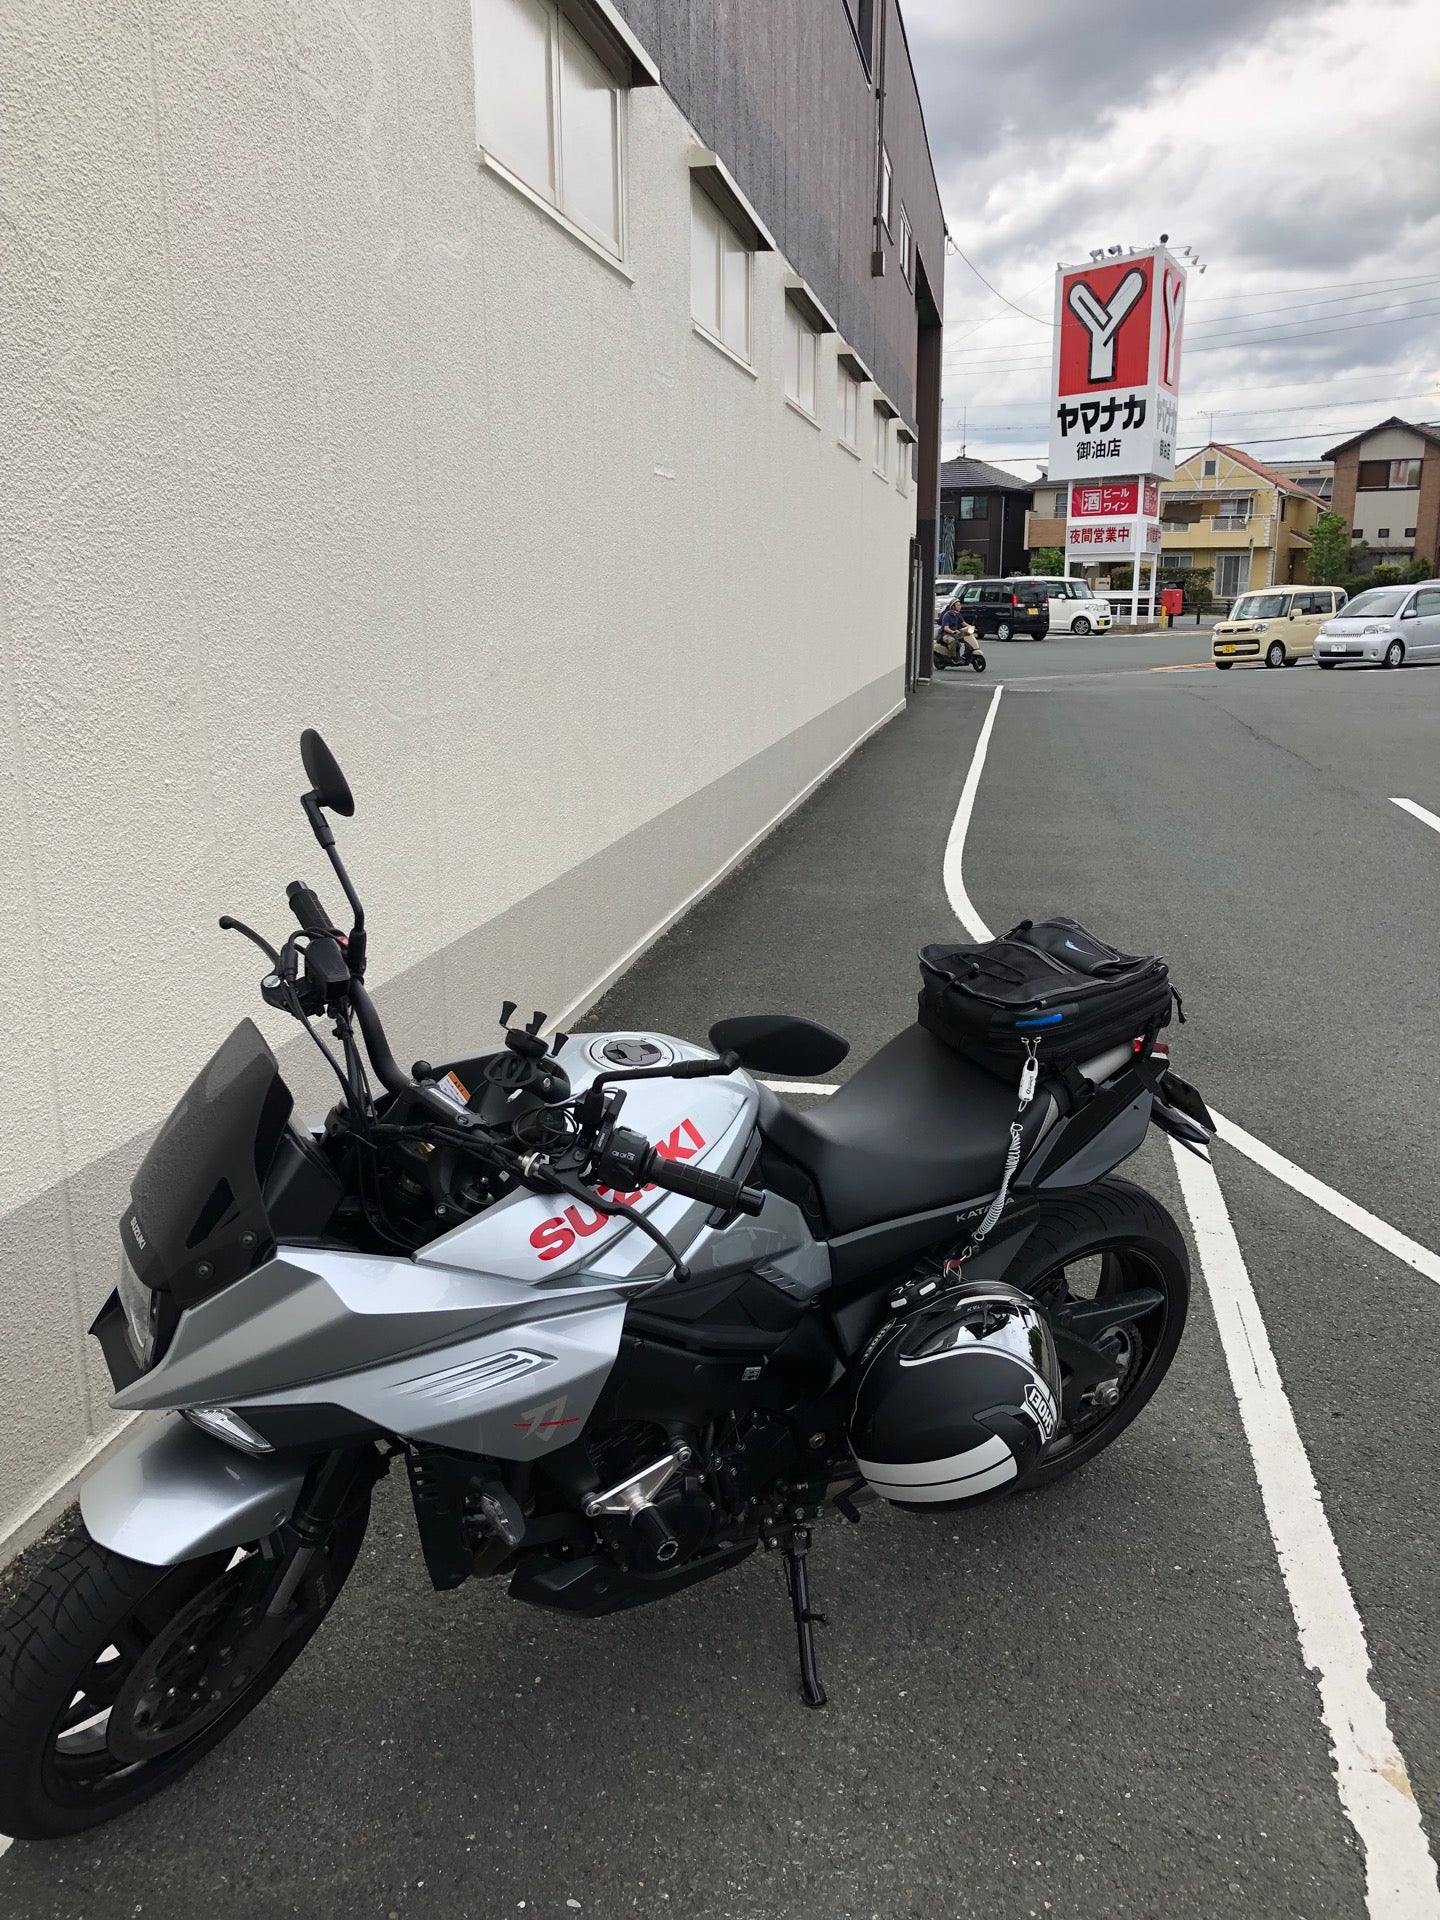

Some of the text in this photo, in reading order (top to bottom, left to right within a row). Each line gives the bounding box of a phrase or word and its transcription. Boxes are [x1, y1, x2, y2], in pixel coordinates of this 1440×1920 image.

[1067, 267, 1147, 385] Y
[1057, 394, 1147, 437] ヤマナカ
[1076, 438, 1122, 461] 御油店
[1084, 492, 1100, 511] 酒
[1103, 488, 1130, 499] ビール
[1103, 502, 1129, 512] ワイン
[1070, 526, 1130, 544] 夜間営業中
[956, 1197, 1015, 1223] KATA
[130, 1216, 146, 1250] SUZUKI
[1028, 1388, 1053, 1435] SHOEI
